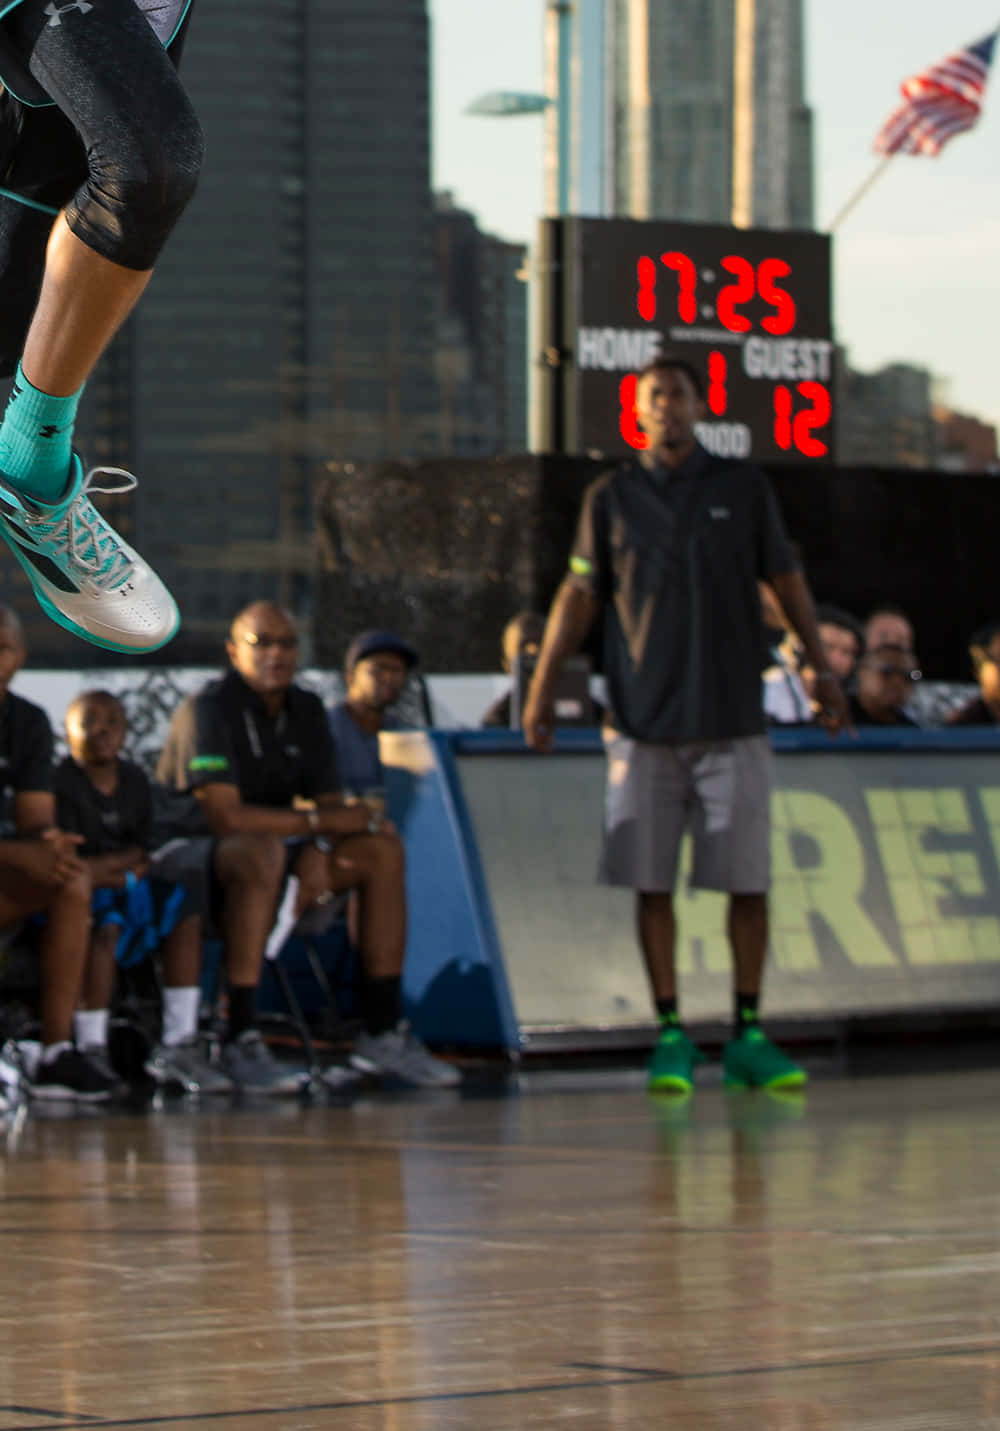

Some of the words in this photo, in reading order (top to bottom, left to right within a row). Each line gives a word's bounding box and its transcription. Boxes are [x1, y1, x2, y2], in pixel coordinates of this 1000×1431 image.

[637, 251, 796, 336] 17:25
[577, 327, 663, 370] HOME
[743, 337, 832, 381] GUEST
[773, 380, 831, 458] 12
